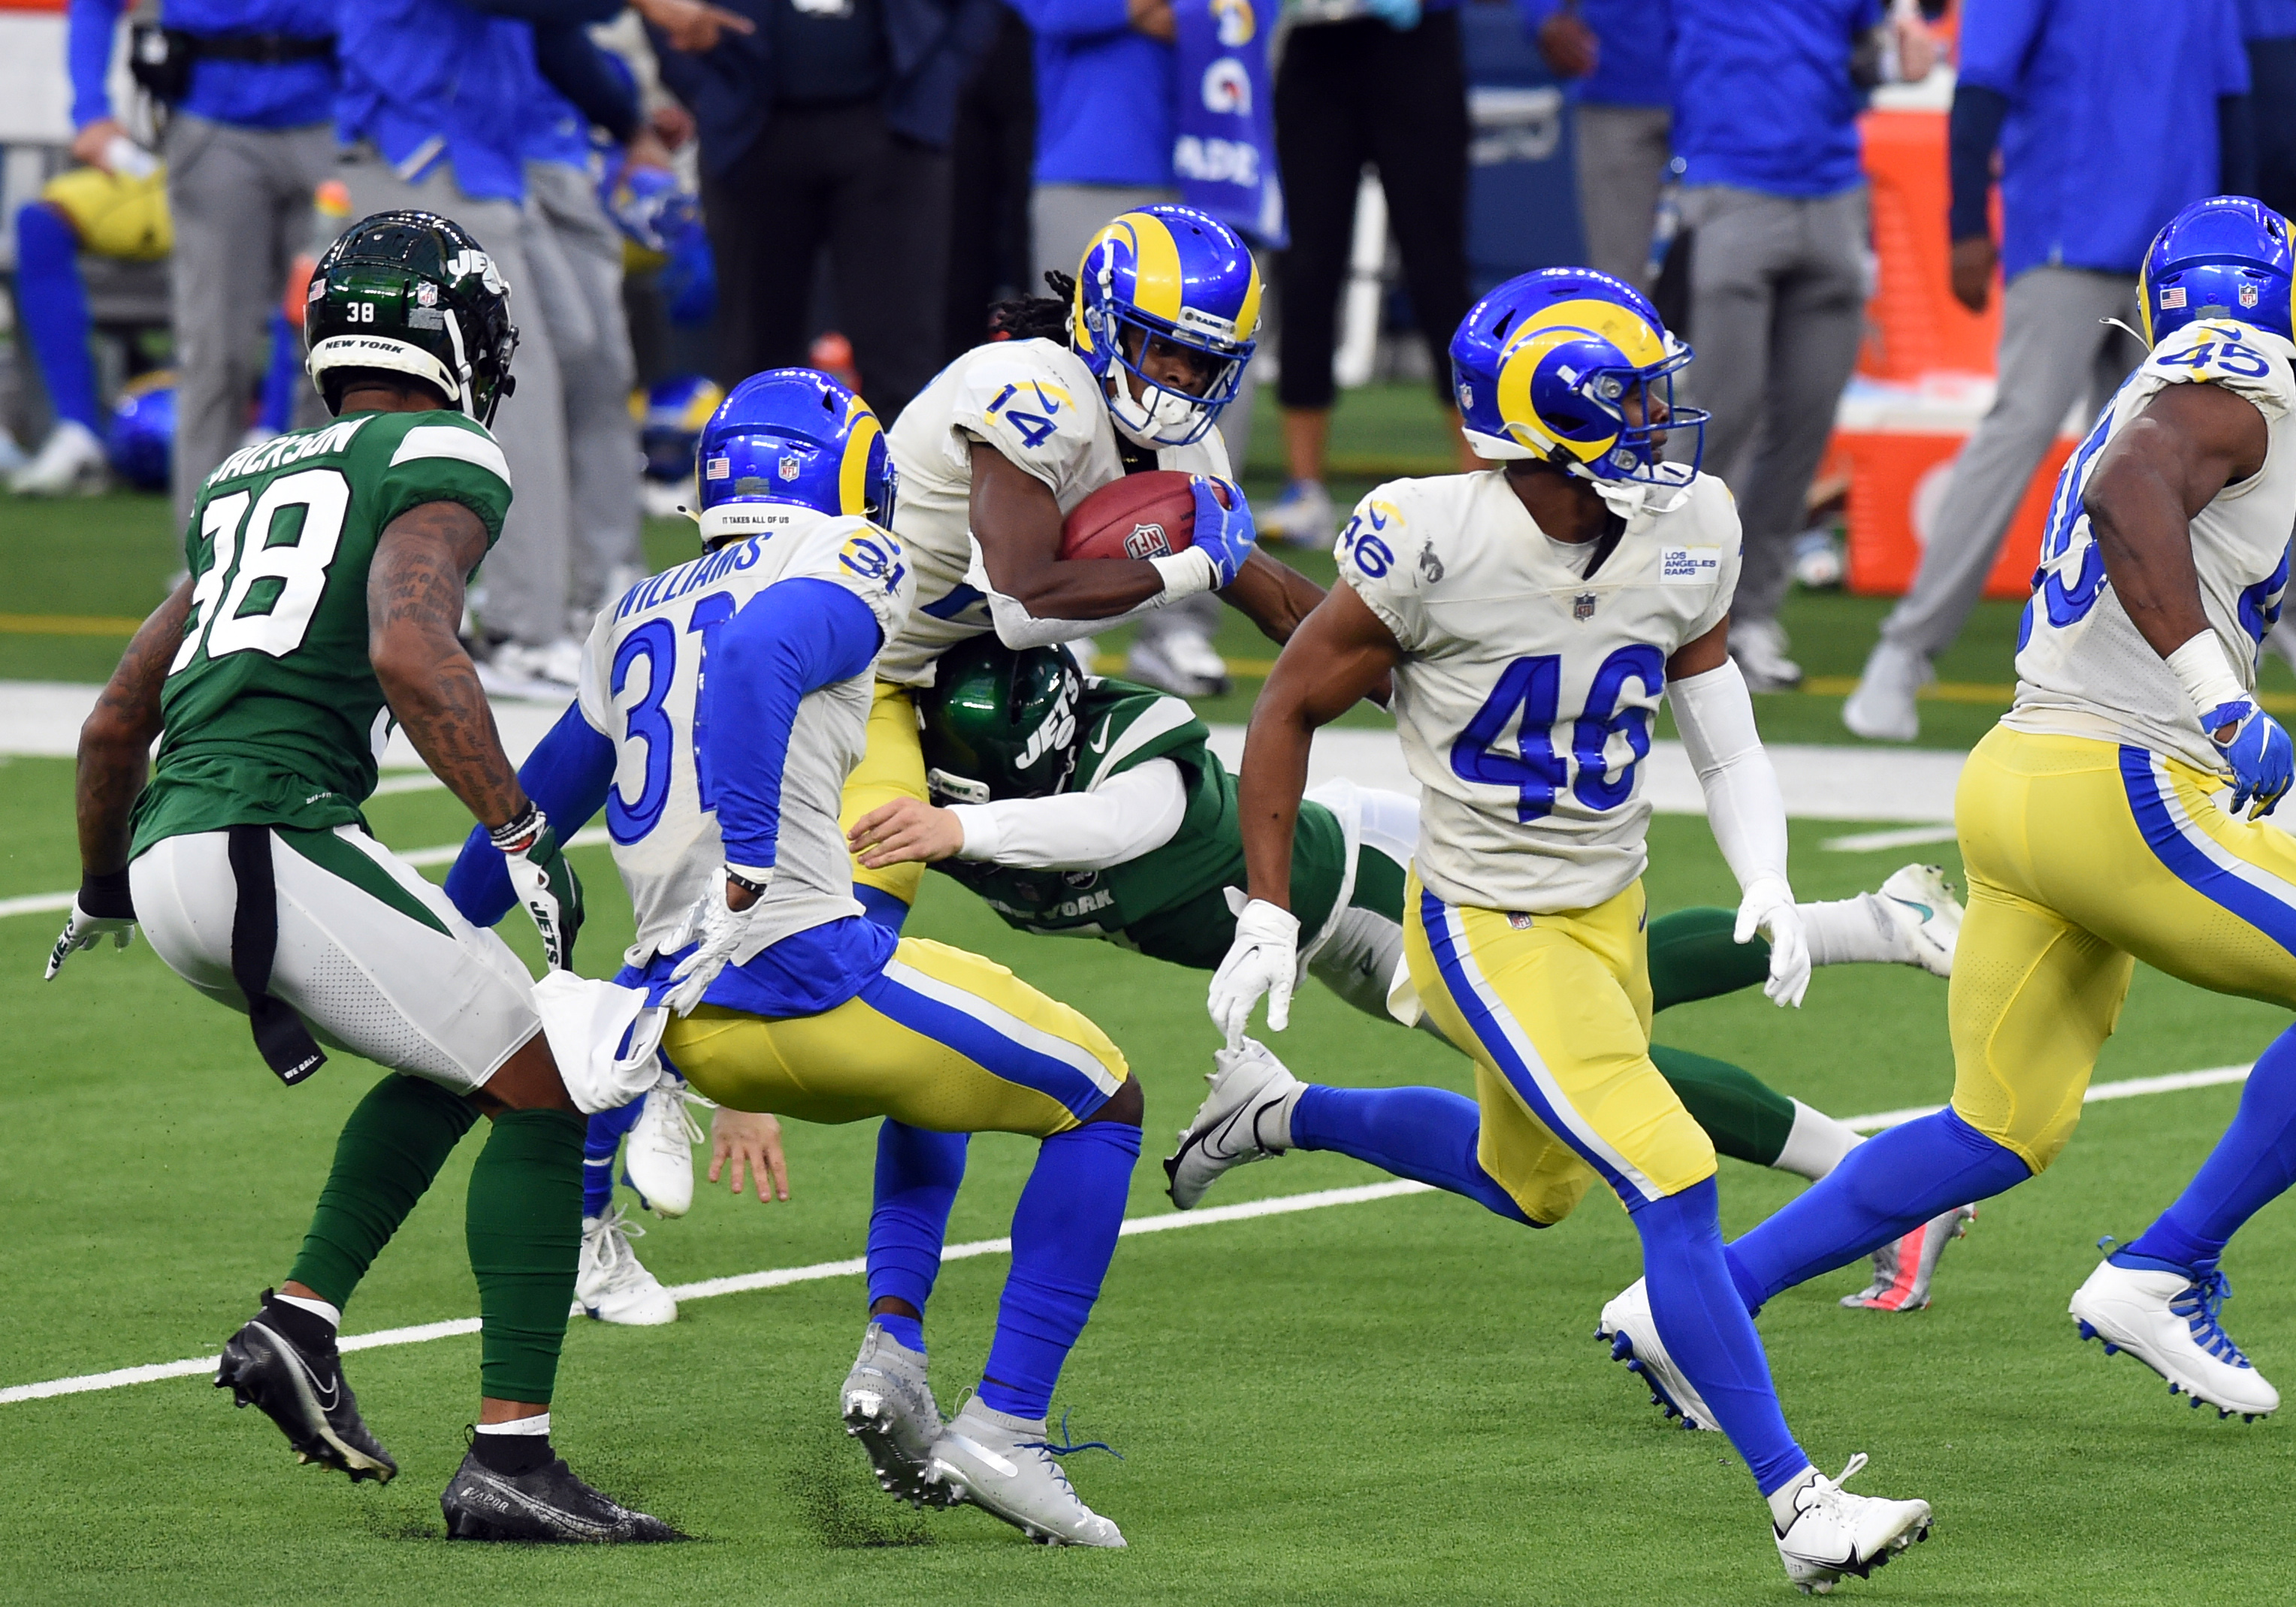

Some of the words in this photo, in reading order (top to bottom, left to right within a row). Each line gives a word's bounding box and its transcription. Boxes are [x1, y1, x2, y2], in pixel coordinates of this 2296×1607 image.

[346, 302, 374, 323] 38
[2242, 294, 2257, 304] NFL
[325, 340, 357, 351] NEW
[359, 340, 407, 354] YORK
[2156, 342, 2270, 379] 45
[986, 383, 1058, 449] 14
[207, 414, 376, 489] JACKSON
[838, 539, 905, 594] 31
[1128, 529, 1164, 557] NFL
[1344, 515, 1395, 578] 46
[1665, 551, 1687, 560] LOS
[1665, 560, 1717, 568] ANGELES
[168, 466, 353, 677] 38
[613, 532, 773, 625] WILLIAMS
[606, 591, 736, 846] 31
[1015, 667, 1080, 770] JETS
[1450, 644, 1666, 823] 46
[530, 901, 559, 965] JETS
[284, 1067, 300, 1080] WE
[298, 1055, 320, 1071] BALL
[469, 1489, 509, 1515] VAPOR
